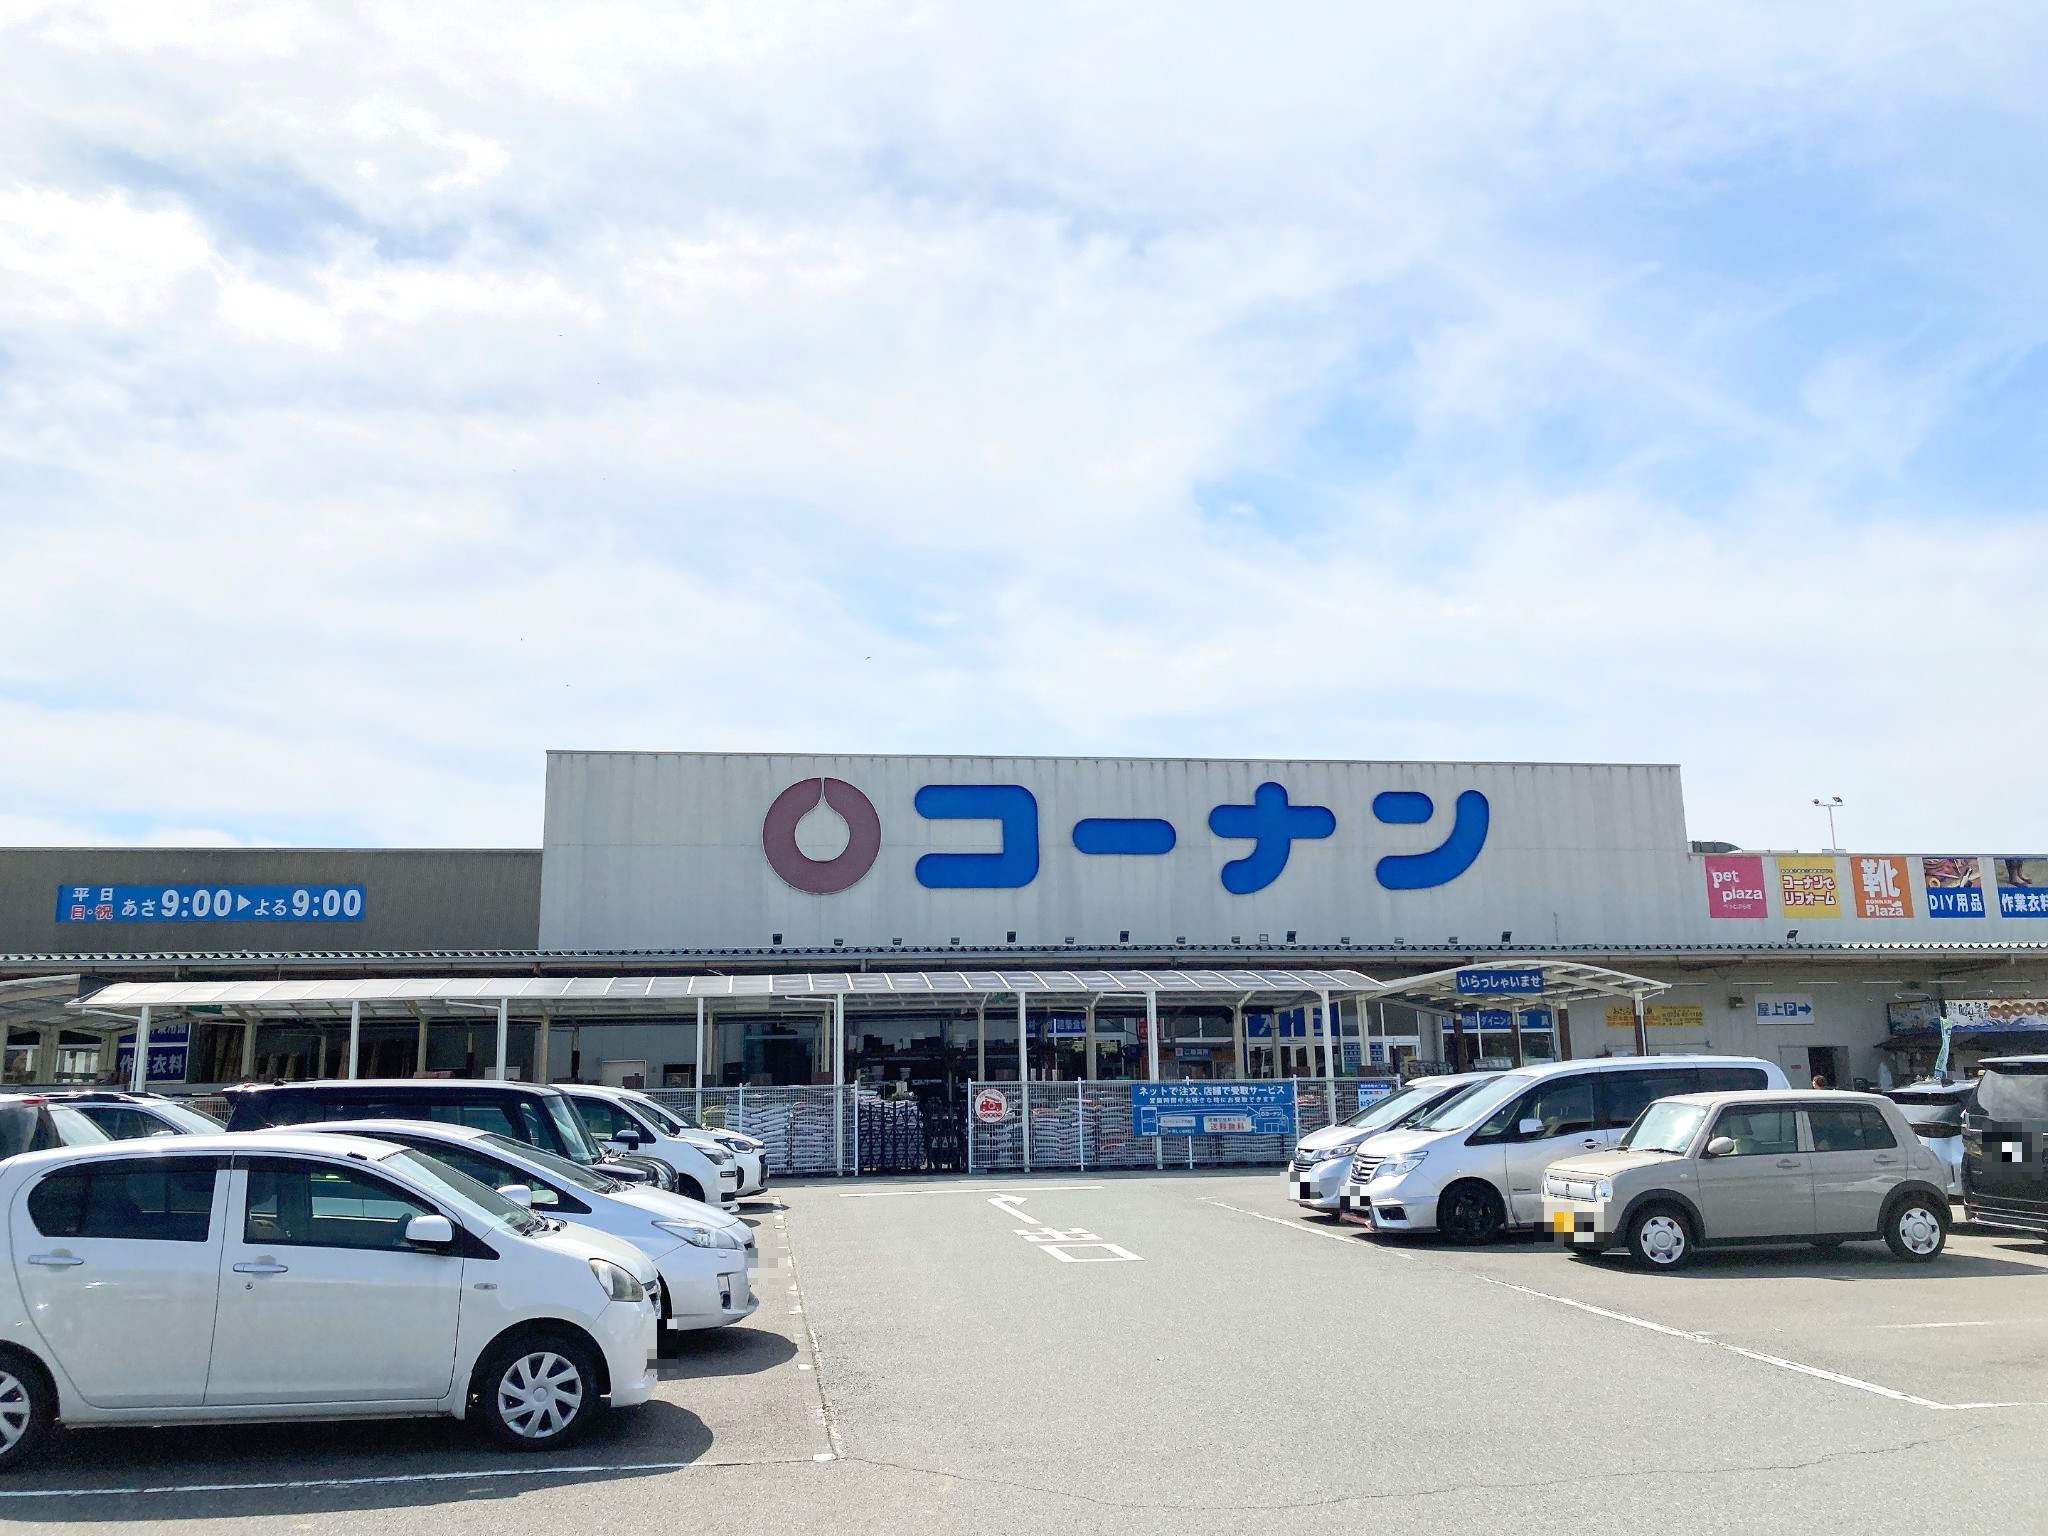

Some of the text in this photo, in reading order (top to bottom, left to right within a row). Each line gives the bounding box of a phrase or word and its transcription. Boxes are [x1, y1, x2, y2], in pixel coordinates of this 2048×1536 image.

[914, 782, 1490, 894] コーナン
[1712, 870, 1740, 889] pet
[1782, 874, 1836, 891] コーナンで
[1860, 858, 1901, 899] 靴
[71, 887, 114, 902] 平日
[1722, 889, 1763, 903] plaza
[1785, 891, 1837, 906] リフォーム
[1929, 893, 1983, 912] DIY用品
[1866, 904, 1904, 917] Plaza
[1459, 975, 1542, 989] いらっしゃいませ
[120, 1053, 183, 1075] 作衣料
[1138, 1085, 1285, 1097] ネットで注文、店舗で受取サービス
[1012, 1227, 1146, 1263] 出口
